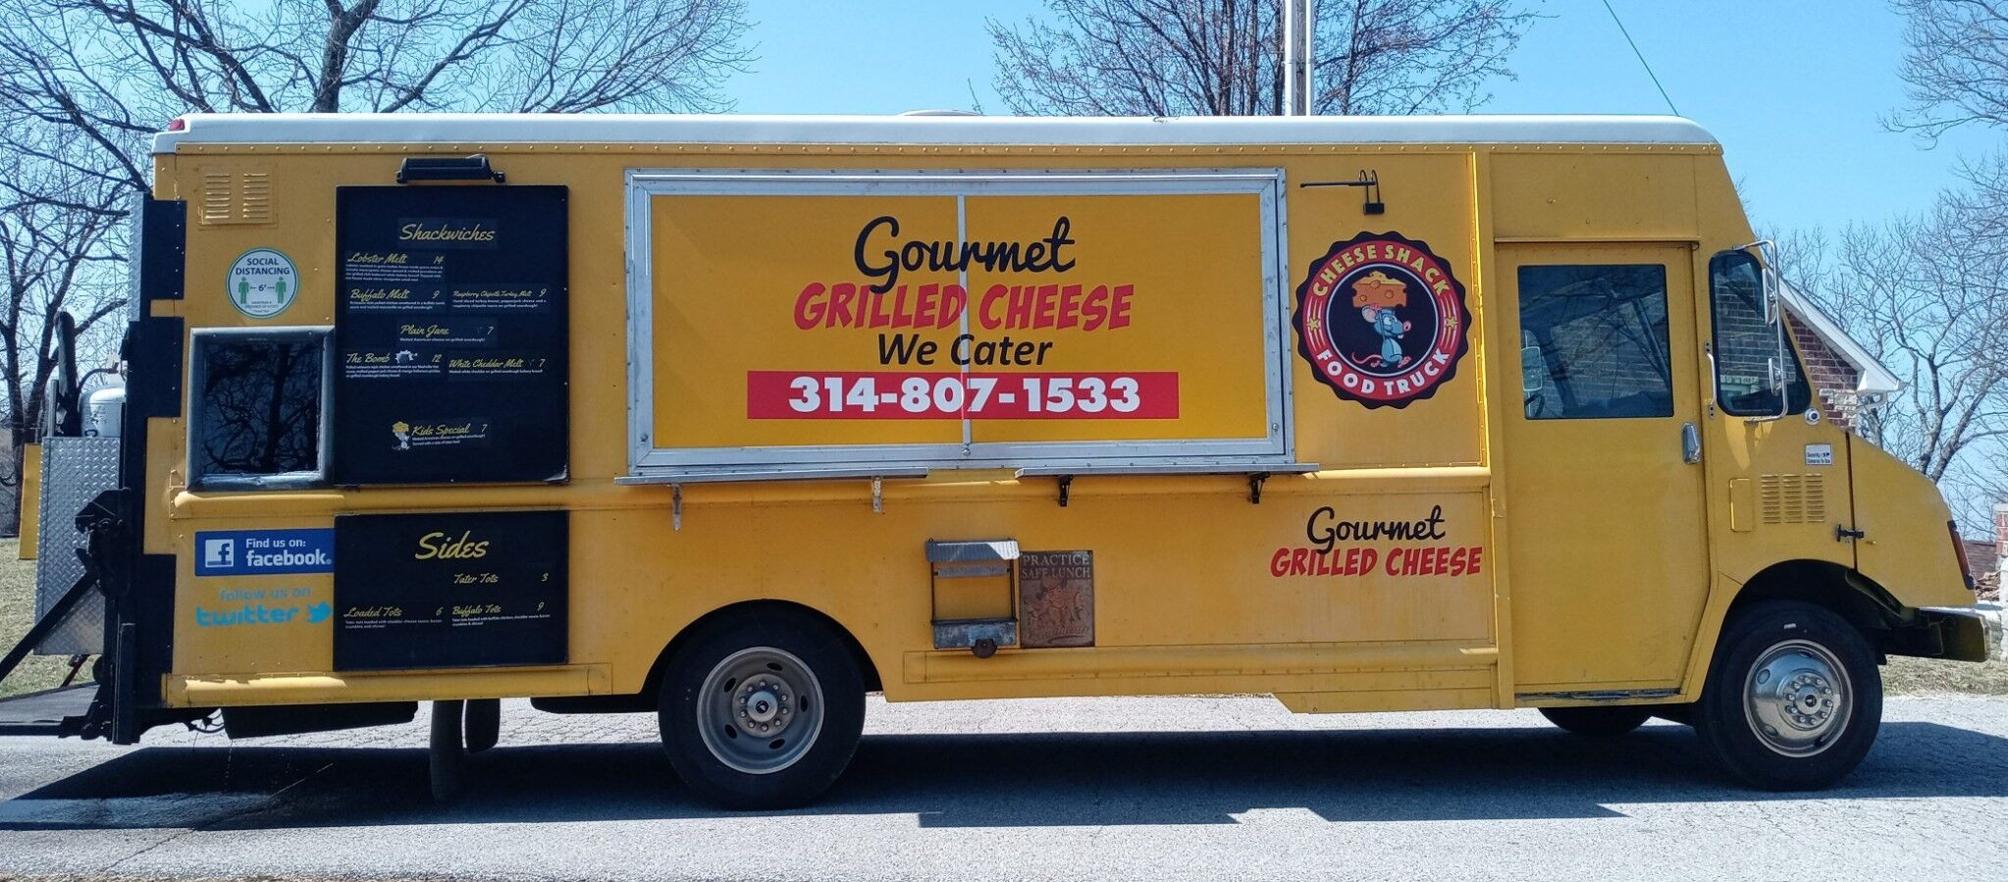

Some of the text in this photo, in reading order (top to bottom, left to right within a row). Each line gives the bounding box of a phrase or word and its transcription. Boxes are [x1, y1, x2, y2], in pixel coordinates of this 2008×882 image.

[399, 222, 496, 241] Shackwiches
[246, 257, 280, 266] SOCIAL
[347, 252, 445, 265] Lobster Melt 14
[853, 215, 1077, 295] Gourmet
[235, 267, 291, 276] DISTANCING
[1313, 243, 1451, 297] CHEESE SHACK
[350, 288, 441, 302] Buffalo Melt 9
[539, 288, 548, 298] 9
[793, 281, 1135, 332] GRILLED CHEESE
[400, 324, 495, 338] Plain Jane 7
[876, 333, 1054, 367] We Cater
[346, 352, 363, 364] The
[364, 352, 391, 363] Bomb
[448, 358, 547, 368] White Cheddar Melt 7
[1316, 347, 1451, 396] FOOD TRUCK
[787, 375, 1141, 414] 314-807-1533
[411, 422, 489, 438] Kids Special 7
[1306, 504, 1447, 556] Gourmet
[246, 538, 307, 549] Find us on:
[415, 530, 490, 560] Sides
[1022, 552, 1090, 566] PRACTICE
[1269, 546, 1484, 578] GRILLED CHEESE
[454, 573, 478, 584] Tater
[480, 572, 499, 584] Tots
[1021, 566, 1092, 580] SAFE LUNCH
[195, 604, 299, 628] twitter
[343, 606, 445, 618] Loaded Tots 6
[452, 604, 483, 618] Buffalo
[484, 603, 502, 614] Tots
